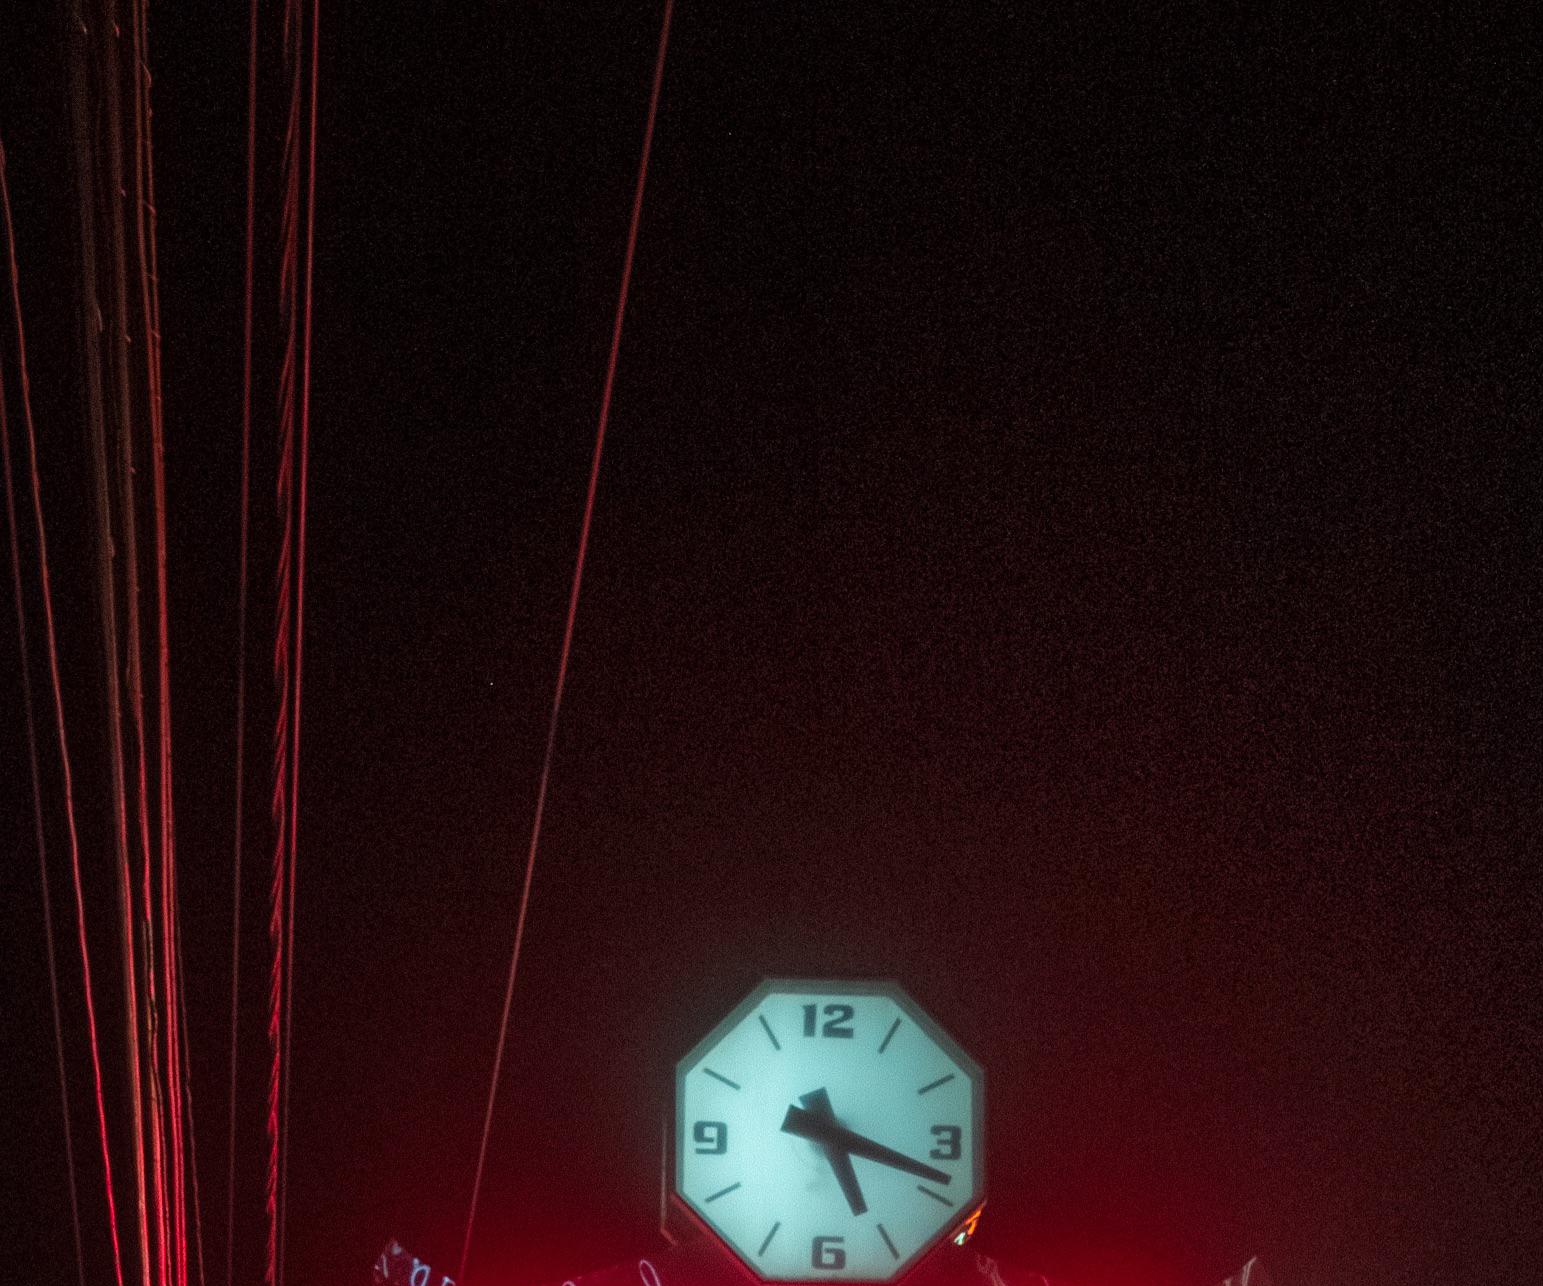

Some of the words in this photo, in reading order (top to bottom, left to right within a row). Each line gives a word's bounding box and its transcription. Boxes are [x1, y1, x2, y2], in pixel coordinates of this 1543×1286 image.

[803, 1004, 855, 1039] 12
[693, 1121, 728, 1155] 9
[930, 1125, 962, 1161] 3
[811, 1236, 847, 1271] 6
